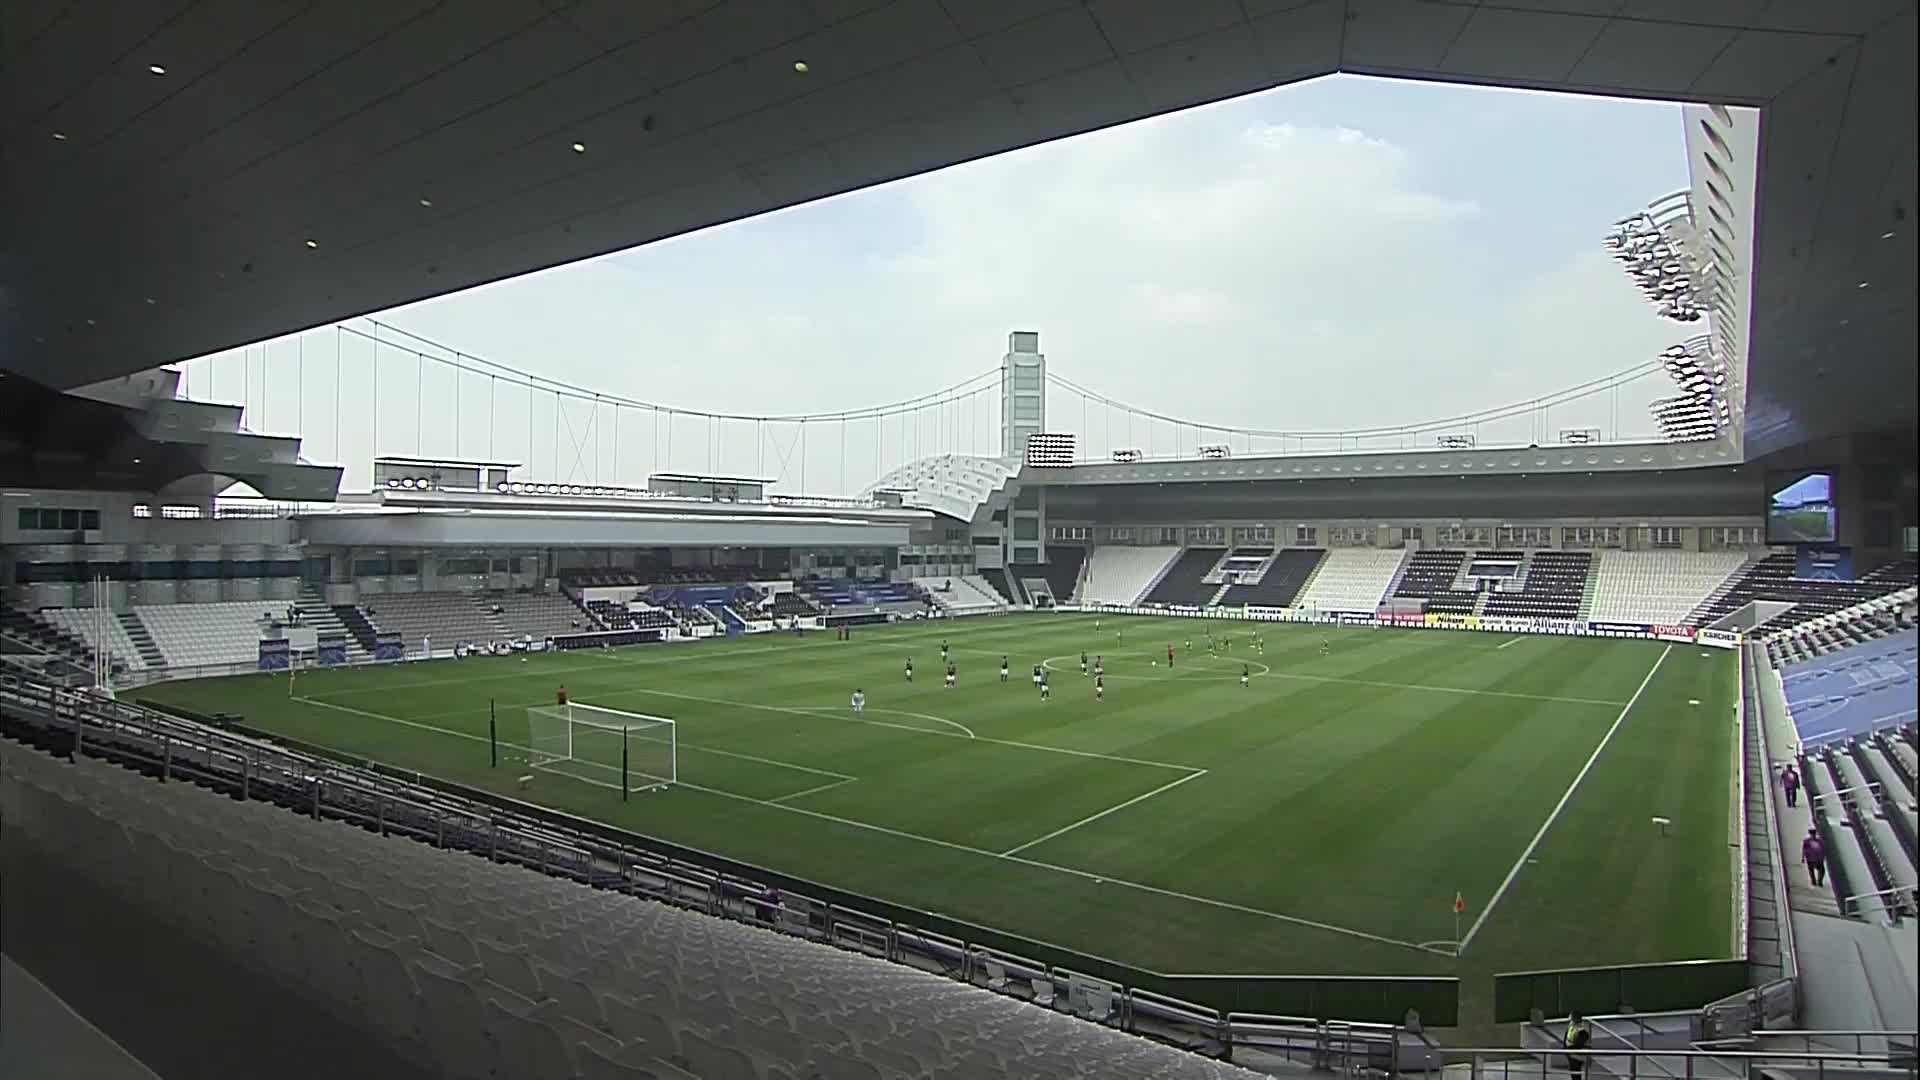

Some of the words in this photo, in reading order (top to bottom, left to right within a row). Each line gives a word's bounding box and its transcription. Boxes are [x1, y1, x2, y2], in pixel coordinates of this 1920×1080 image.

[1436, 616, 1465, 624] Nikon
[1533, 617, 1569, 629] Allianz
[1654, 625, 1689, 636] TOYOTA
